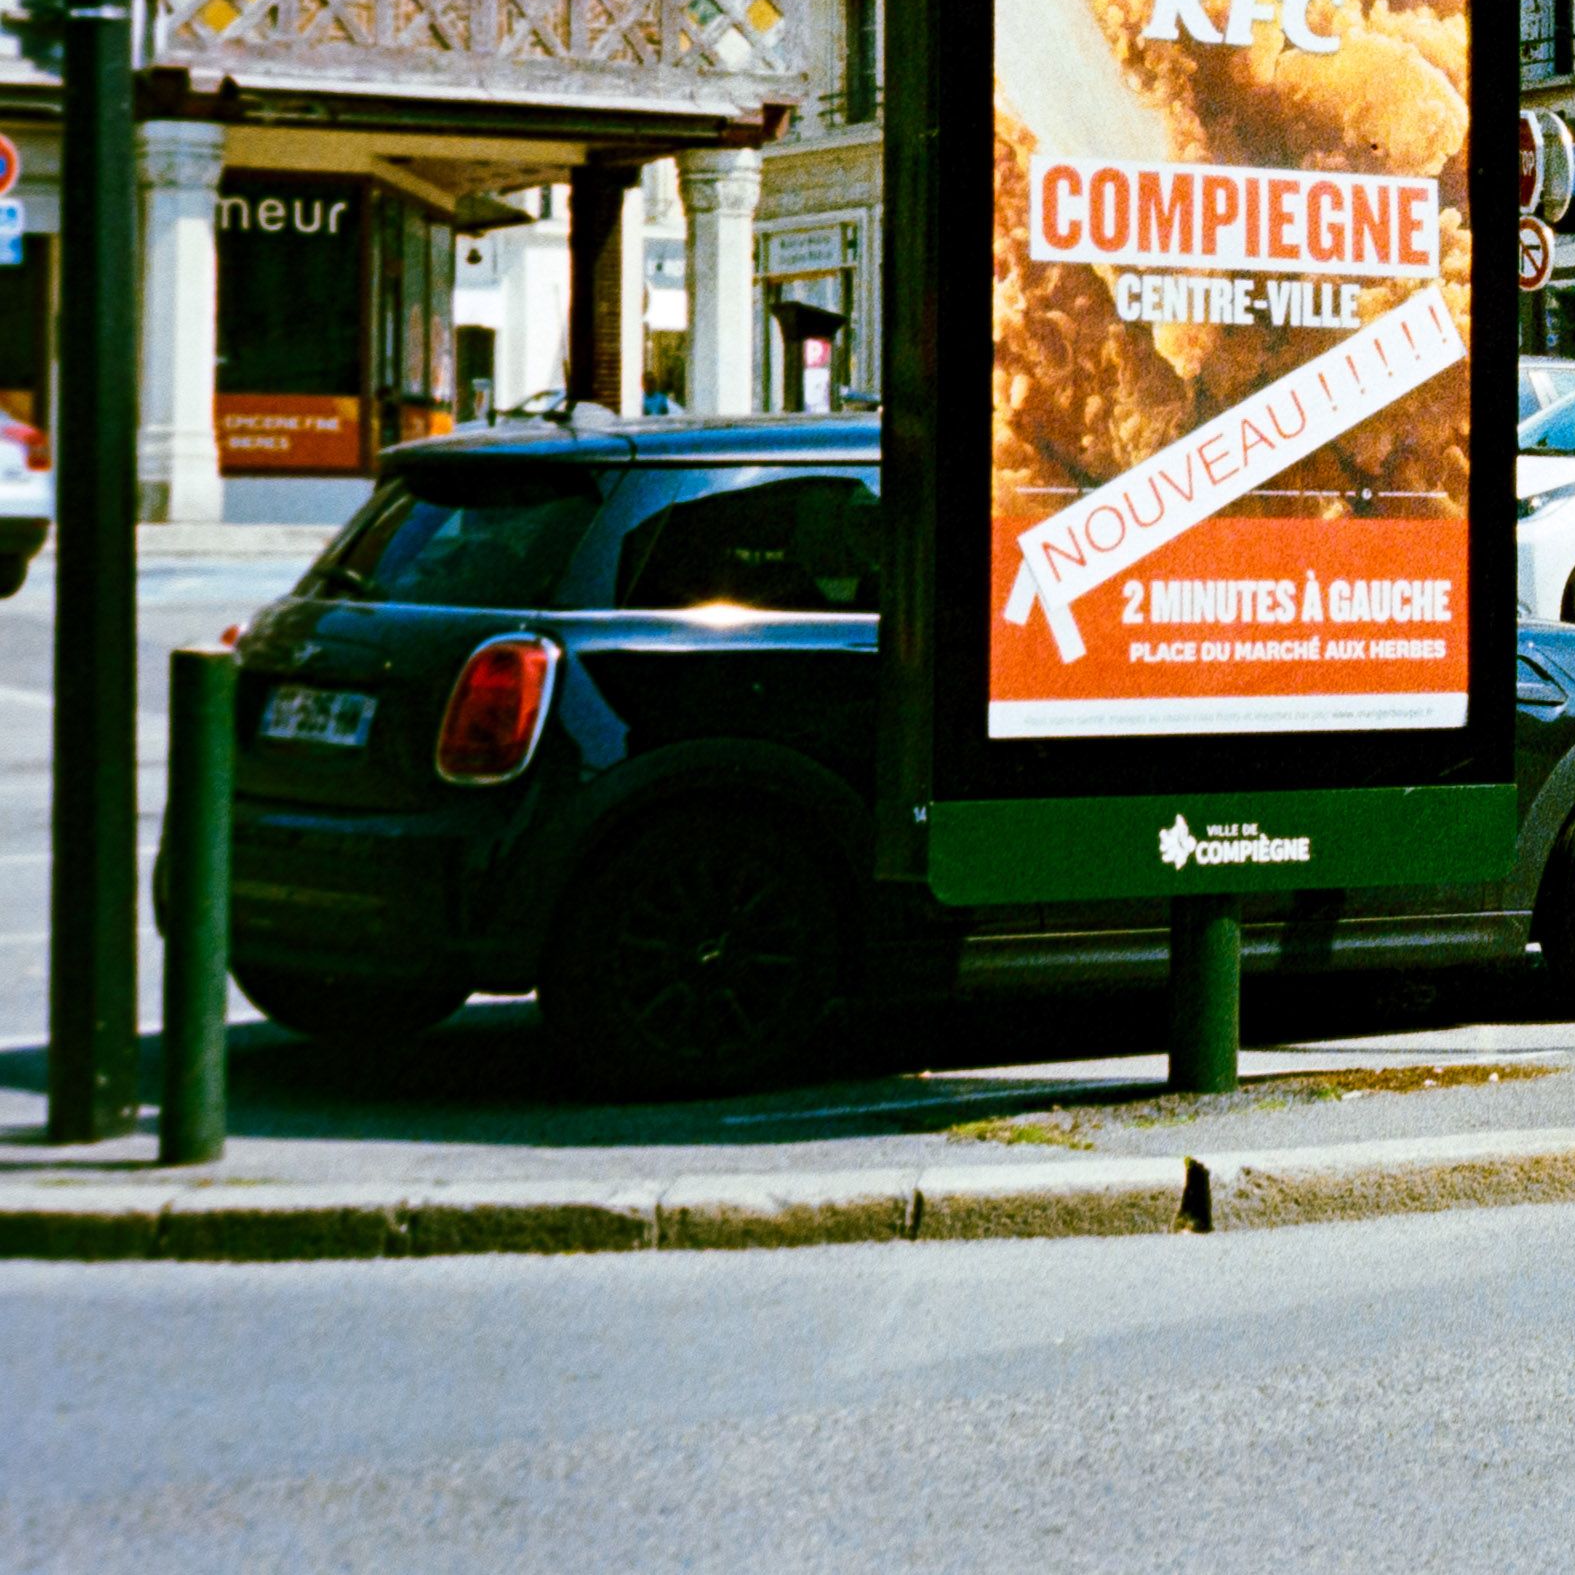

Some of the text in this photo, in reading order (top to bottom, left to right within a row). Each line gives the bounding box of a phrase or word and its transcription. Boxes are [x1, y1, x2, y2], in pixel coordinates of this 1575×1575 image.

[1040, 162, 1430, 267] COMPIEGNE
[1117, 273, 1360, 327] CENTRE-VILLE
[1040, 387, 1308, 582] NOUVEAU
[1123, 570, 1453, 624] 2 MINUTES À GAUCHE
[1129, 634, 1447, 664] PLACE DU MARCHÉ AUX HERBES
[1195, 834, 1311, 865] COMPIÈGNE
[1206, 823, 1259, 837] VILLE DE
